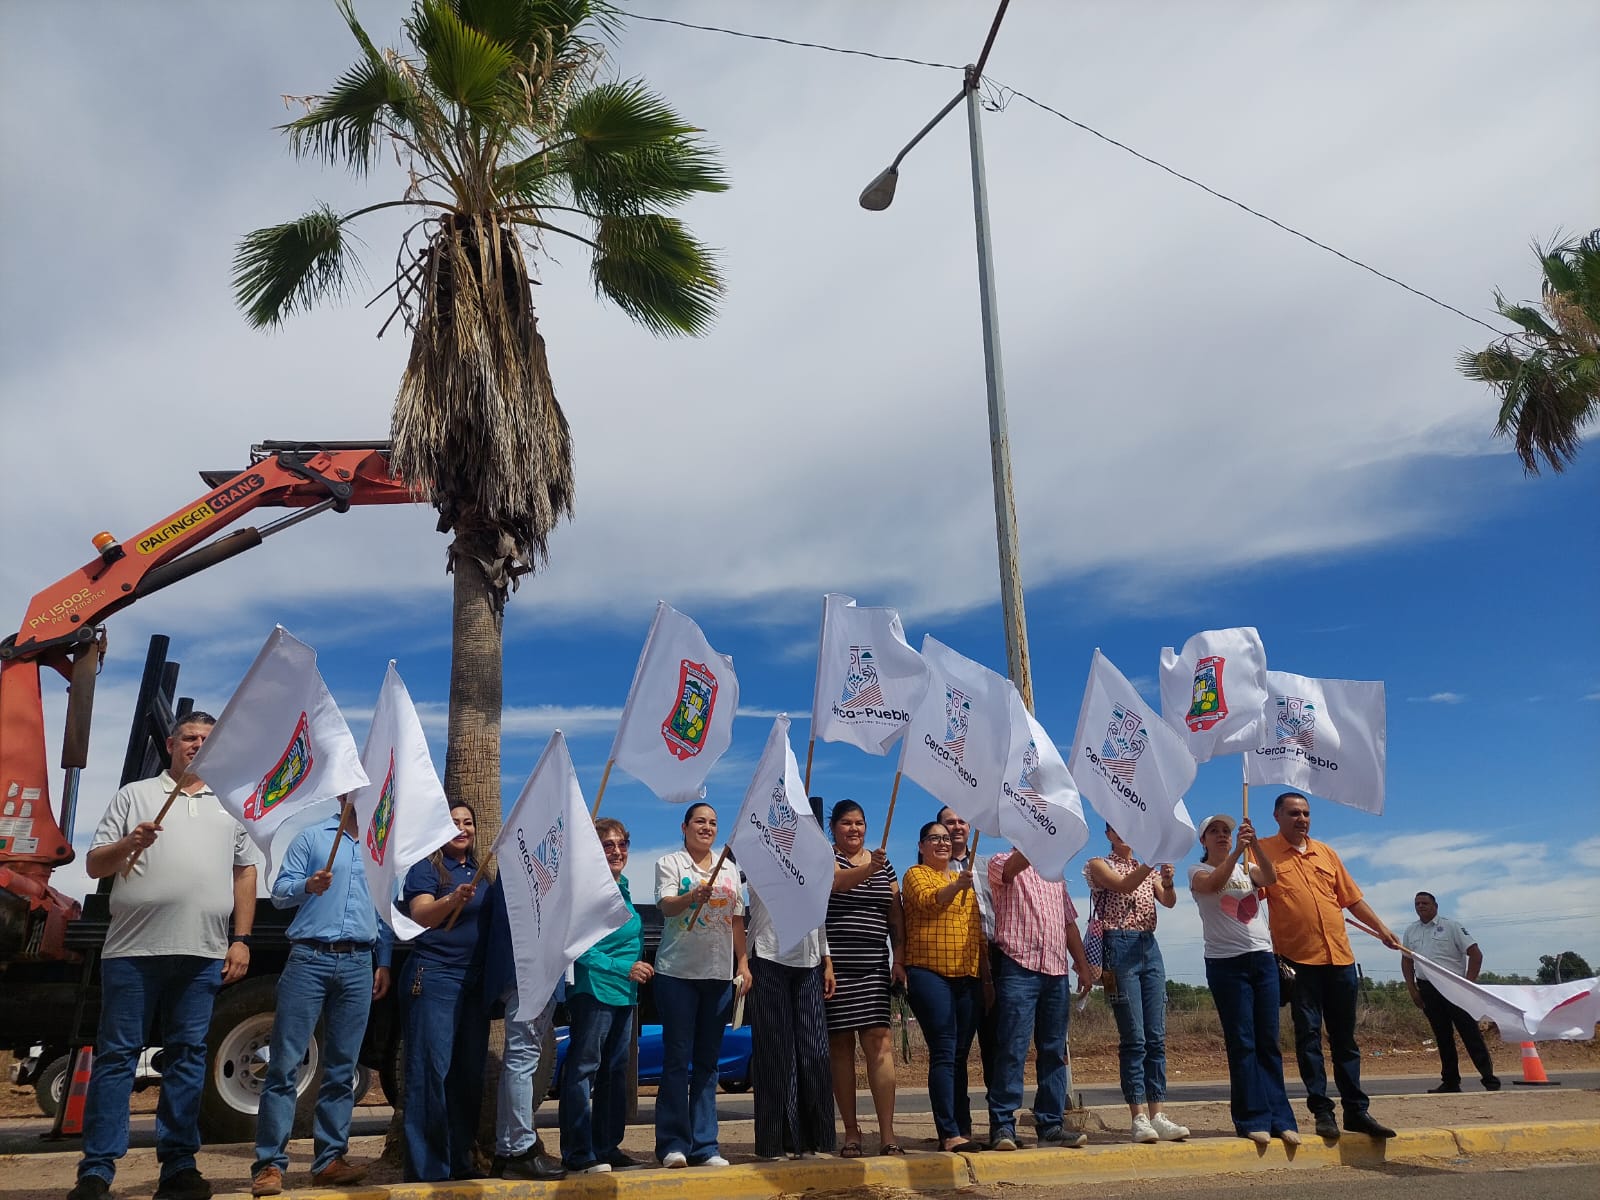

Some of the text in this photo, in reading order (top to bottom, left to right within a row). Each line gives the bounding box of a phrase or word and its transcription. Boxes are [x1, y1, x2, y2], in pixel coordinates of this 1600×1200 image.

[140, 475, 260, 551] PALFINGER CRANE
[29, 588, 92, 629] PK 15002
[51, 589, 106, 624] Performance
[865, 708, 910, 722] Pueblo
[924, 734, 950, 760] Cerca
[1296, 747, 1338, 771] Pueblo
[1111, 774, 1147, 812] Pueblo
[1029, 804, 1057, 835] Pueblo
[517, 828, 534, 875] Cerca
[775, 844, 805, 885] Pueblo
